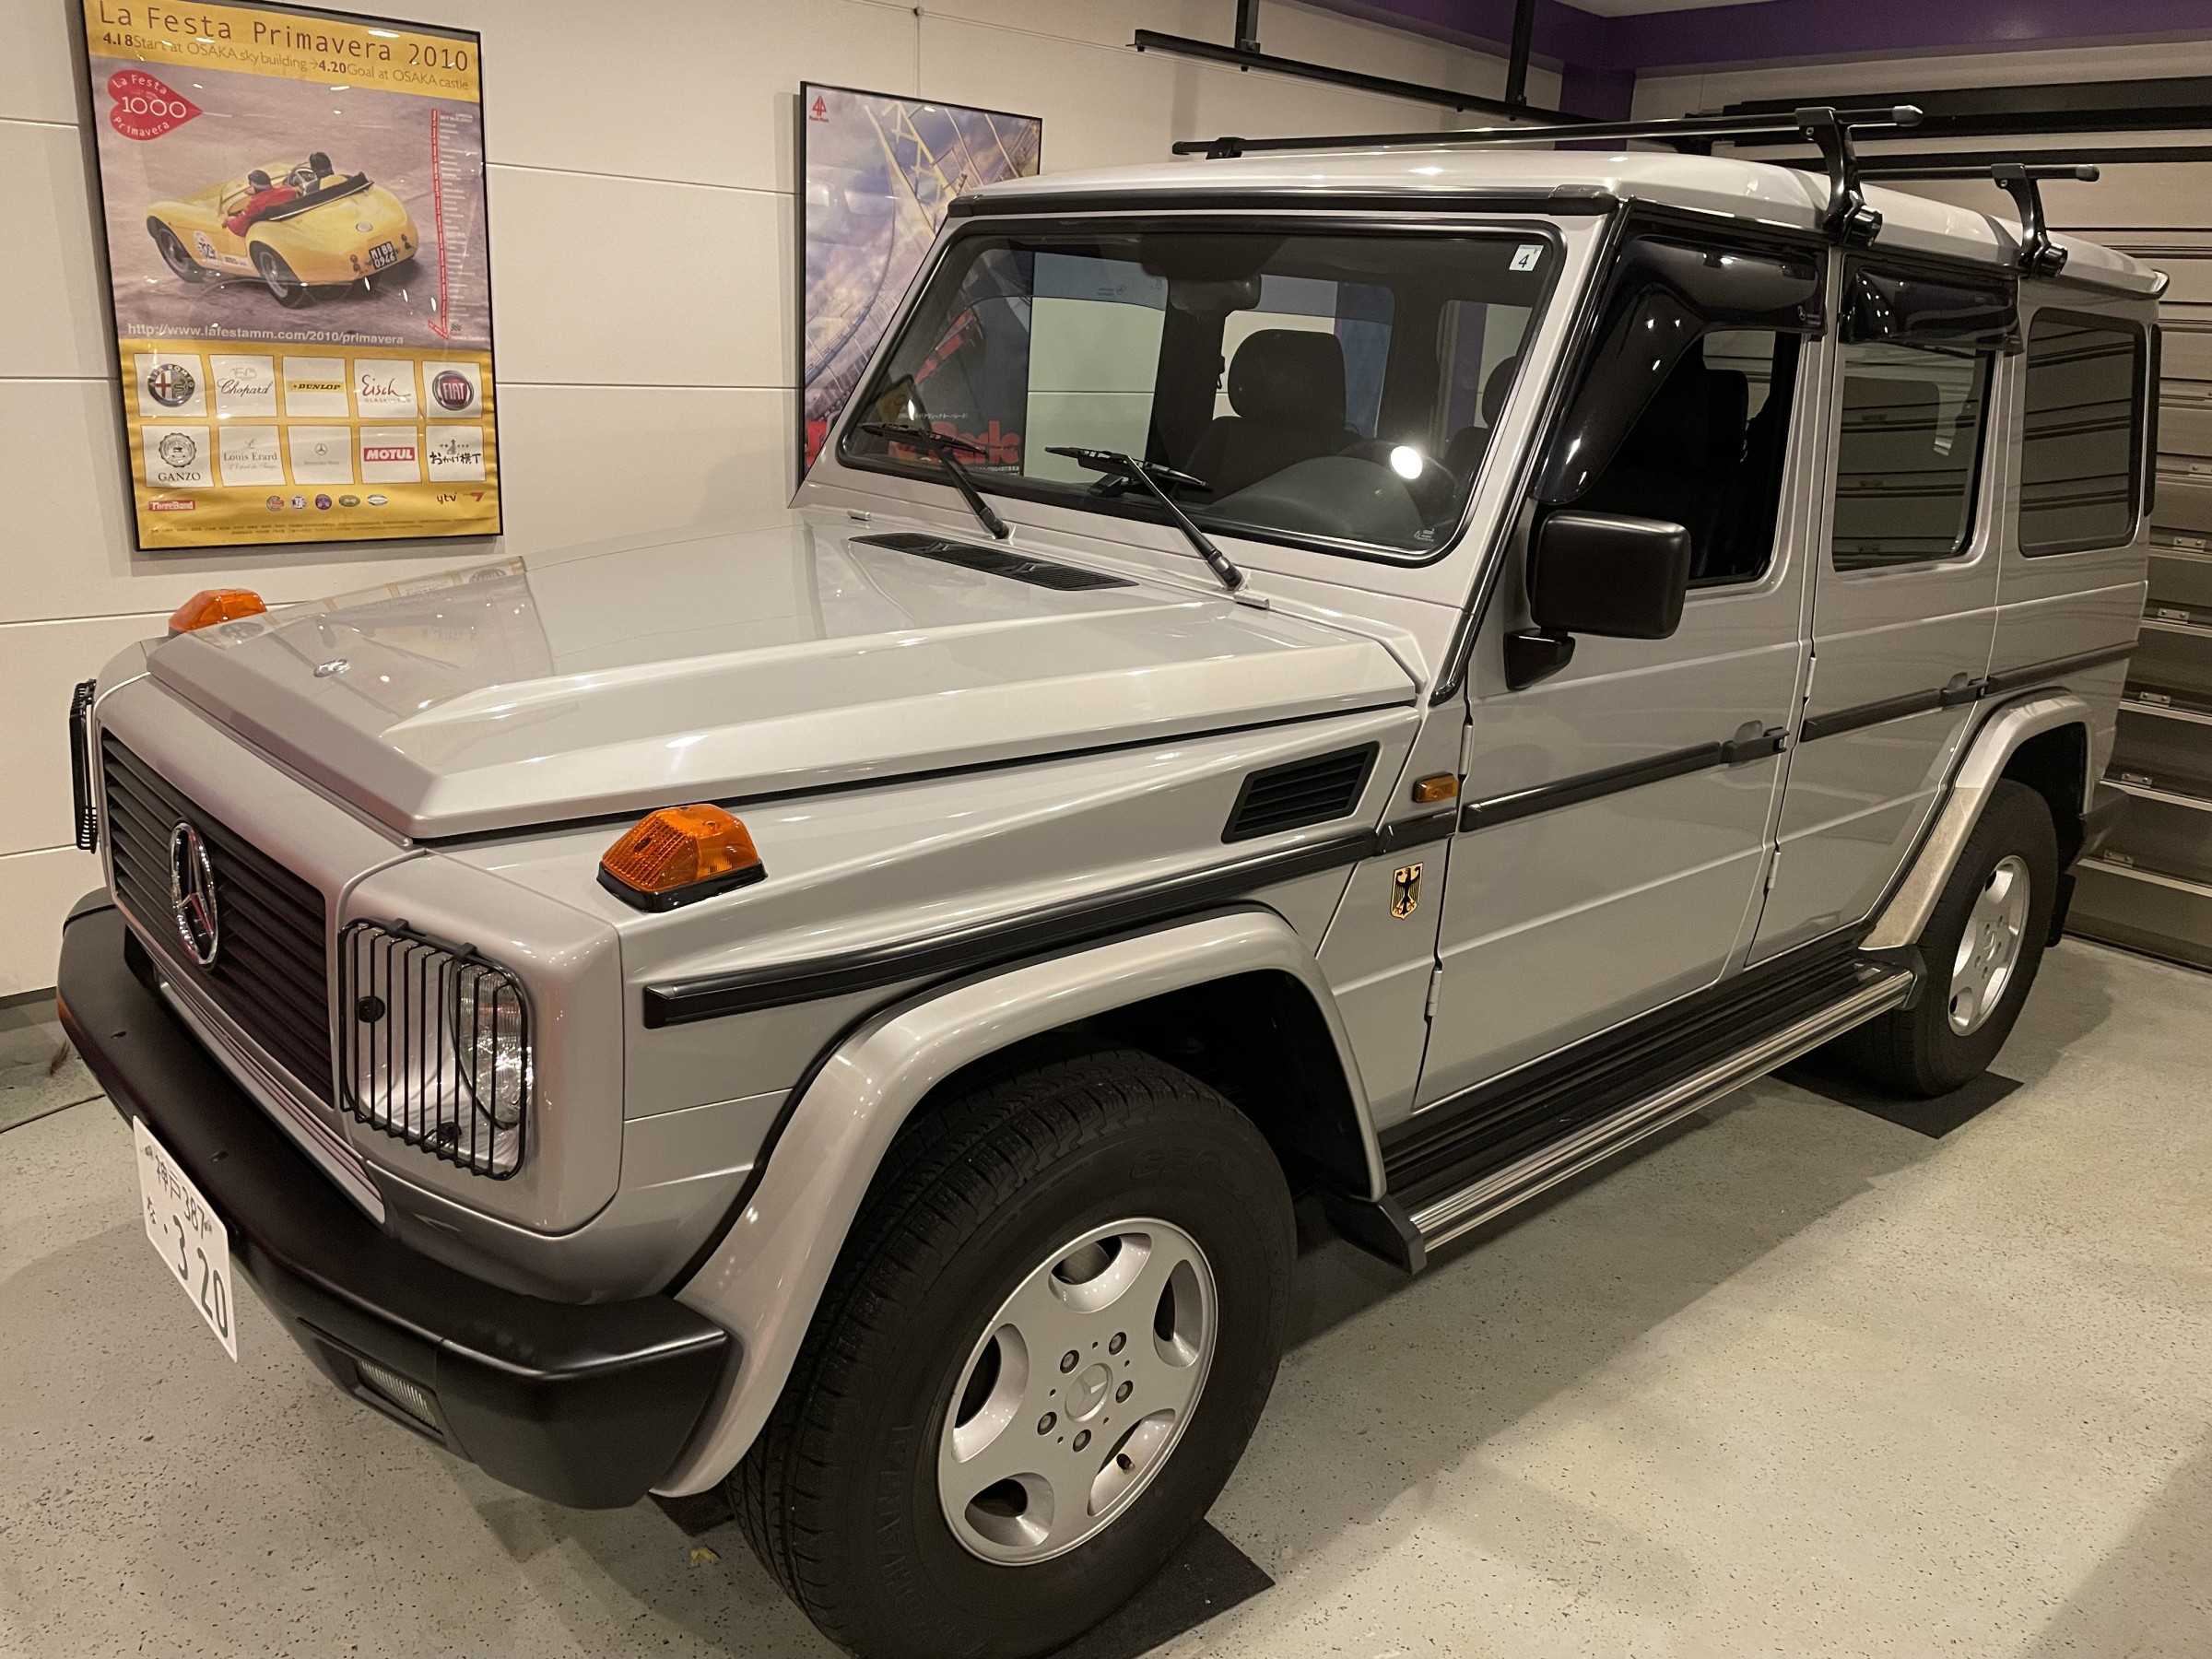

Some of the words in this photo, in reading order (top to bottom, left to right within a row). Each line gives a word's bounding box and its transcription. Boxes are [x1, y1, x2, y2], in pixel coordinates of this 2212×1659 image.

[100, 0, 132, 27] La
[147, 6, 231, 40] Festa
[253, 20, 391, 61] Primavera
[408, 43, 468, 71] 2010
[187, 42, 238, 60] OSAKA
[393, 70, 437, 86] OSAKA
[112, 77, 128, 88] La
[131, 74, 167, 95] Festa
[122, 96, 187, 119] 1000
[113, 116, 171, 137] Primavera
[1518, 253, 1530, 269] 4
[217, 378, 274, 397] Chopard
[298, 382, 341, 391] DUNLOP
[442, 382, 465, 400] FIAT
[223, 452, 249, 462] Louis
[366, 449, 414, 460] MOTUL
[158, 472, 201, 482] GANZO
